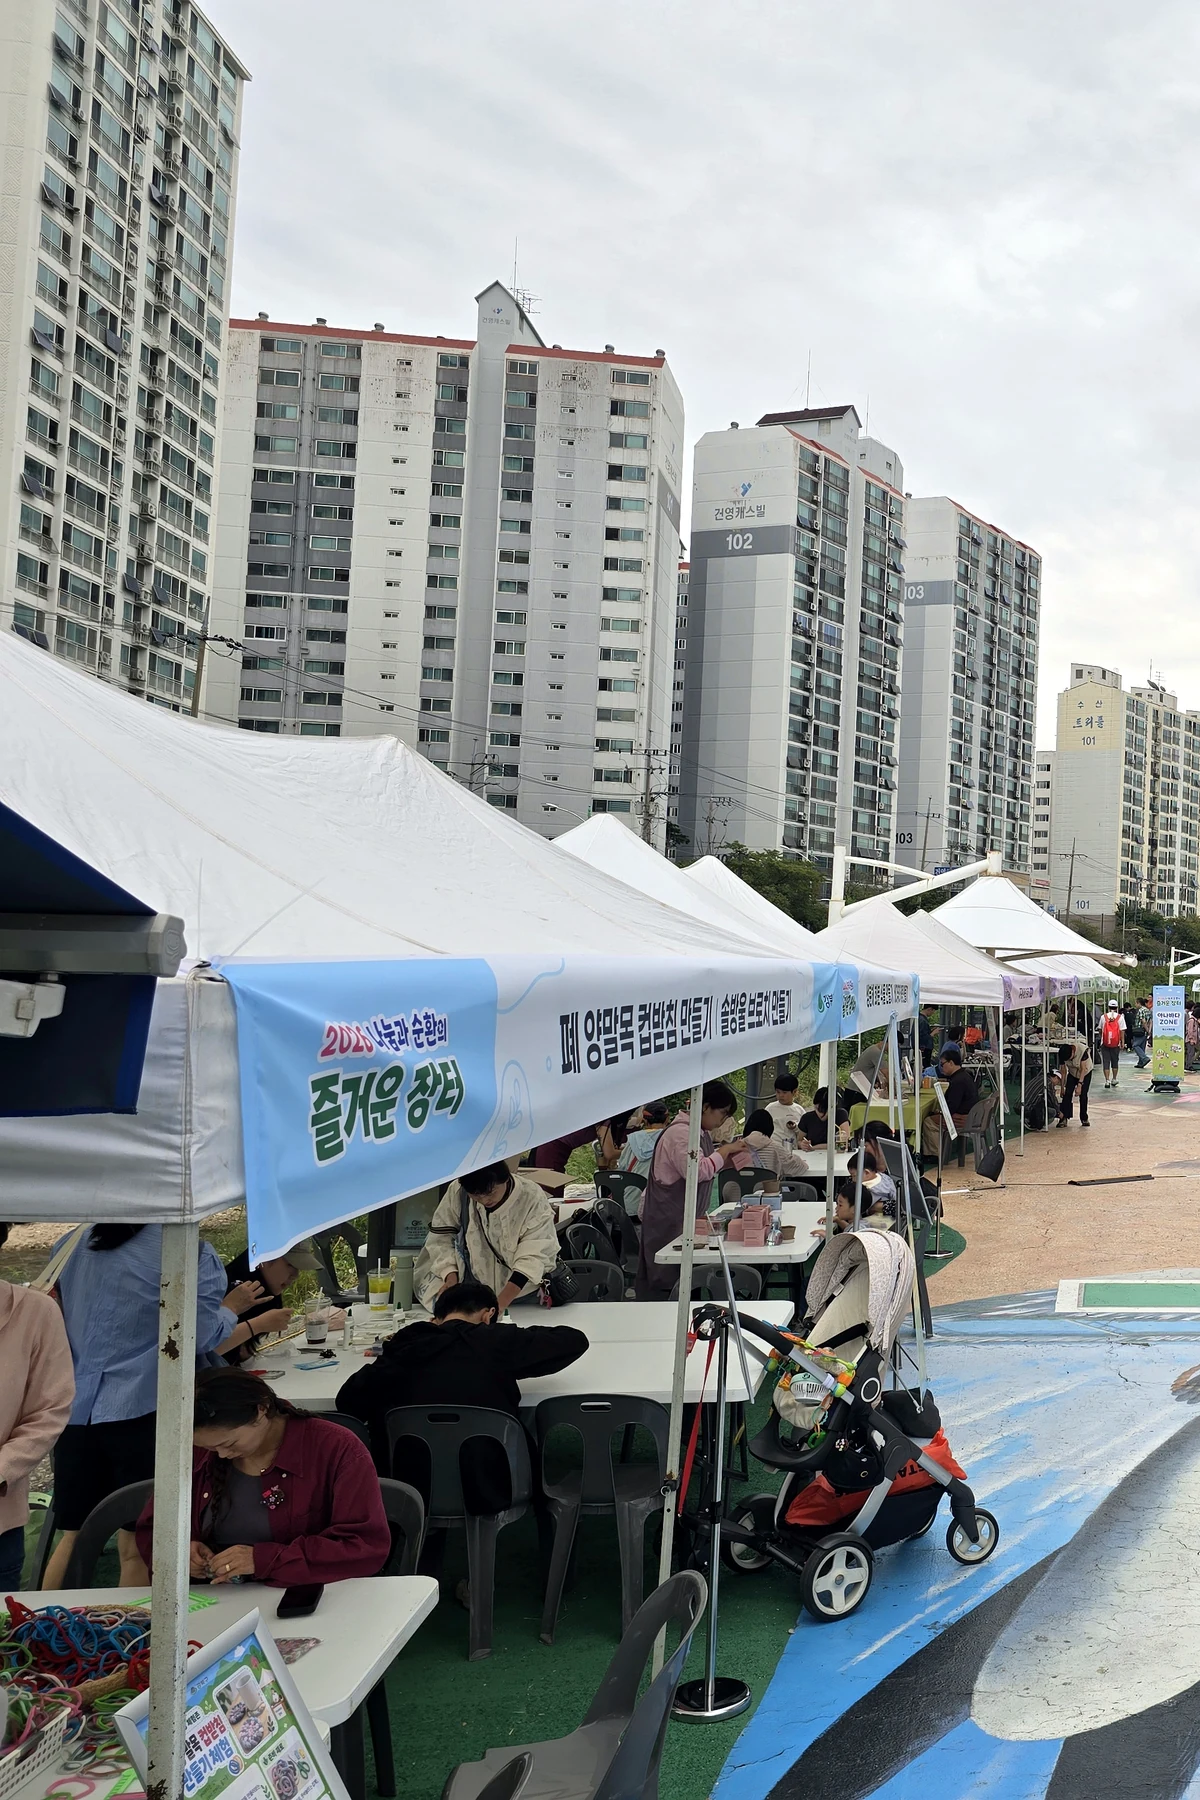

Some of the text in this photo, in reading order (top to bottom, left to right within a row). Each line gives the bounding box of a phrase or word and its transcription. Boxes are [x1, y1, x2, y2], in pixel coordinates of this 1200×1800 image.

[714, 504, 766, 521] 건영캐스빌
[726, 532, 753, 551] 102
[1081, 736, 1096, 746] 101
[1075, 900, 1090, 909] 101
[320, 1012, 447, 1058] 2026 나눔과 순환의
[559, 1011, 581, 1075] 폐
[583, 1004, 634, 1070] 양말목
[638, 999, 678, 1057] 컵받침
[680, 995, 714, 1047] 만들기
[721, 991, 748, 1037] 솔방울
[747, 990, 772, 1029] 브로치
[771, 989, 792, 1025] 만들기
[310, 1059, 465, 1162] 즐거운 장터
[197, 1714, 227, 1747] 컵받침
[184, 1755, 213, 1792] 만들기
[208, 1736, 235, 1765] 체험
